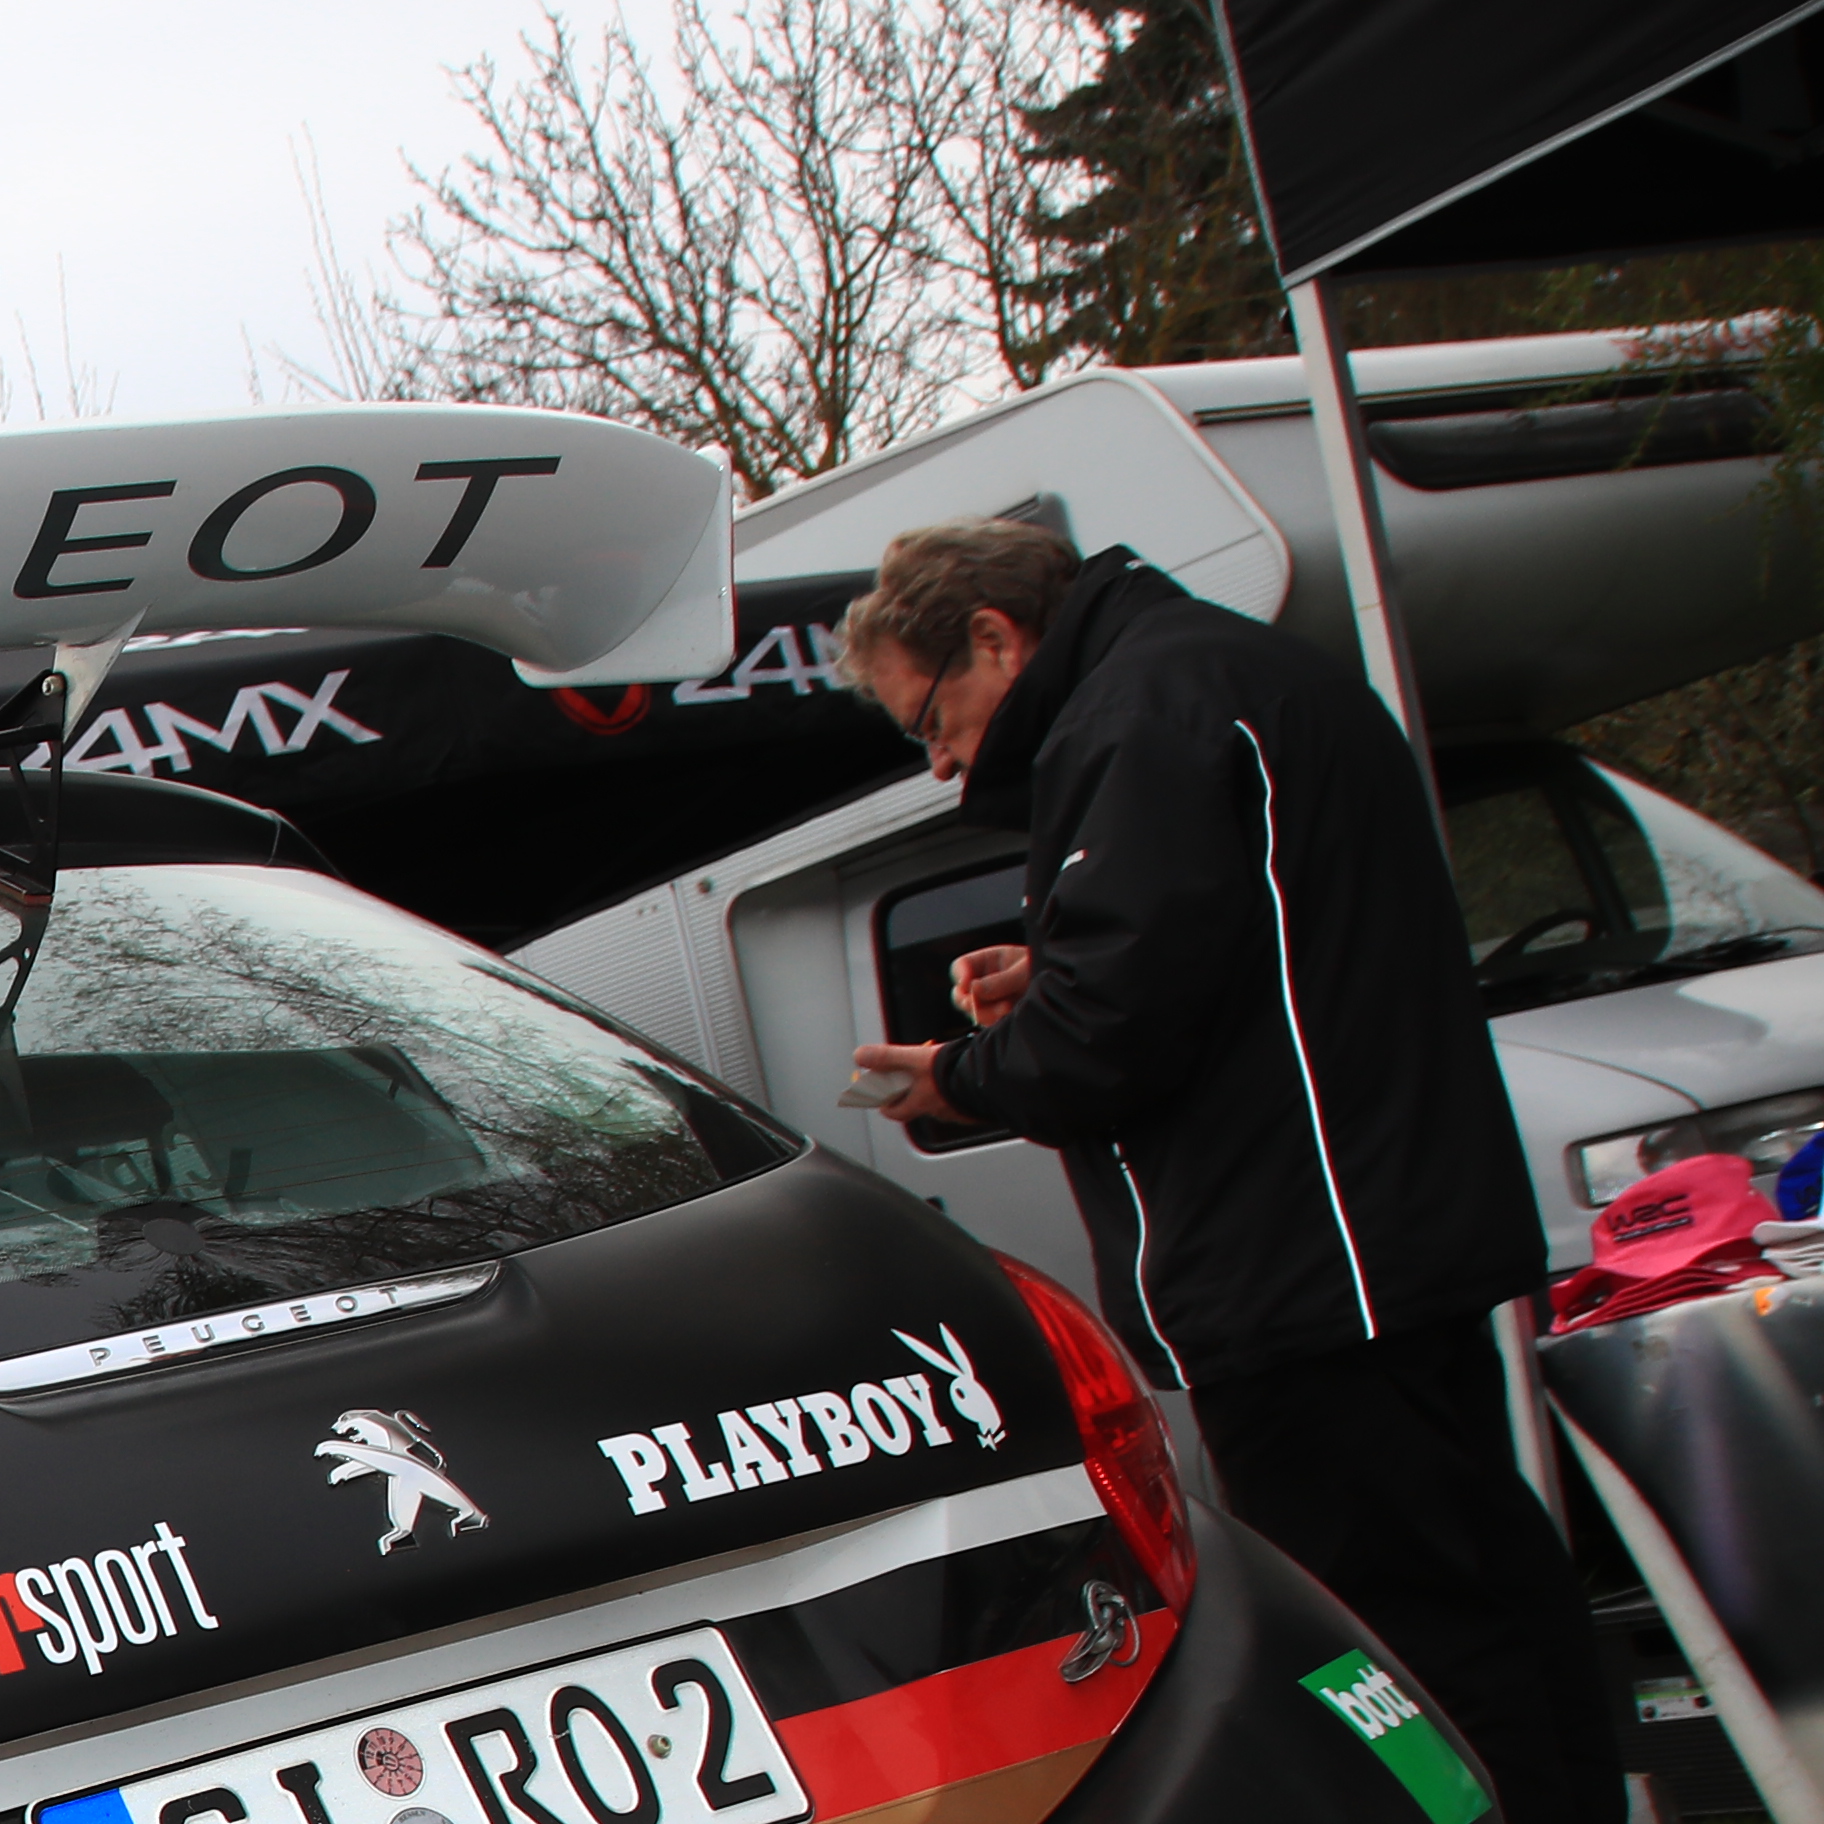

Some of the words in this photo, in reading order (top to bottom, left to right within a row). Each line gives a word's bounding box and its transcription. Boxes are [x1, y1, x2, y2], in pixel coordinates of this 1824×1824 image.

[89, 1287, 399, 1366] PEUGEOT
[598, 1373, 951, 1515] PLAYBOY
[1320, 1663, 1420, 1740] bott
